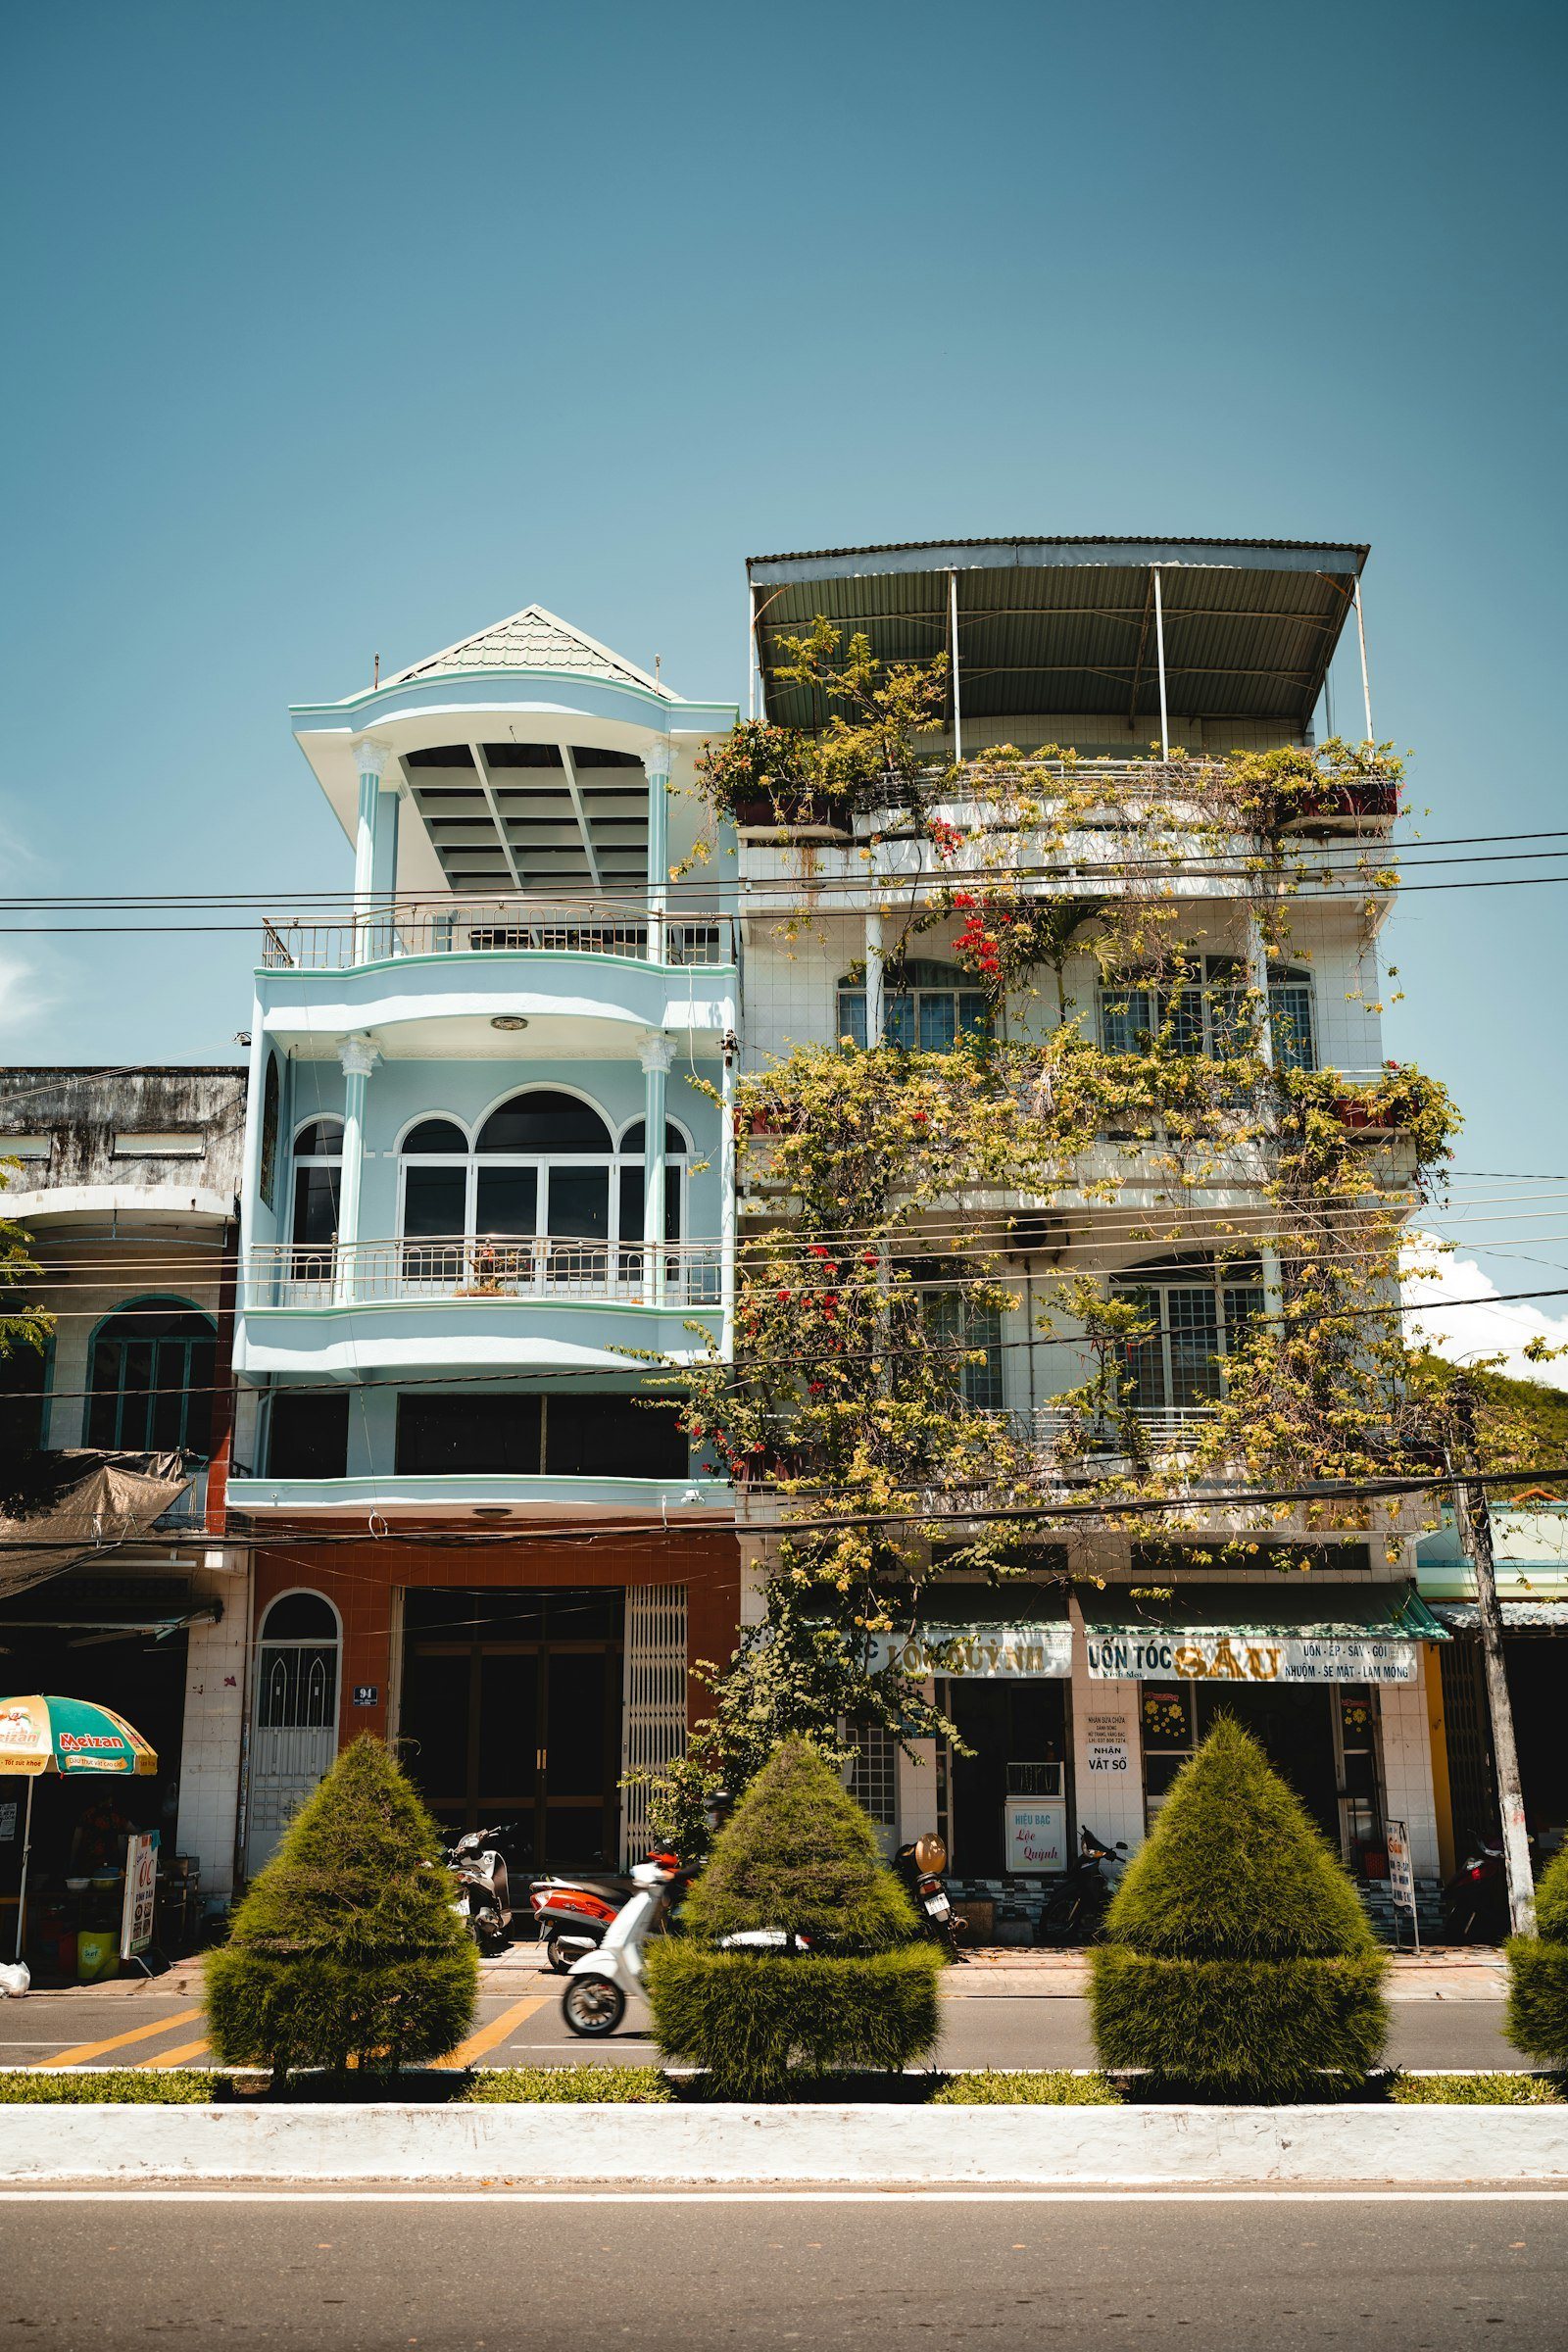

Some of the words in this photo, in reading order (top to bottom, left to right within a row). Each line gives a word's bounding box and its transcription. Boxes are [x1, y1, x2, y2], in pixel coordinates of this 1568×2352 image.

[1089, 1637, 1127, 1669] UỐN
[1133, 1640, 1172, 1669] TÓC
[1285, 1662, 1315, 1679] NHUỘM
[1323, 1665, 1334, 1677] SE
[1337, 1662, 1354, 1681] MẶT
[1363, 1662, 1381, 1678] LÀM
[1383, 1662, 1408, 1679] MÓNG
[0, 1733, 37, 1742] eizan
[60, 1734, 123, 1751] Meizan
[1094, 1745, 1121, 1755] NHẬN
[1015, 1813, 1033, 1827] HIỆU
[1035, 1814, 1051, 1827] BẠC
[1015, 1829, 1036, 1843] Lộc
[1023, 1845, 1058, 1862] Quỳnh
